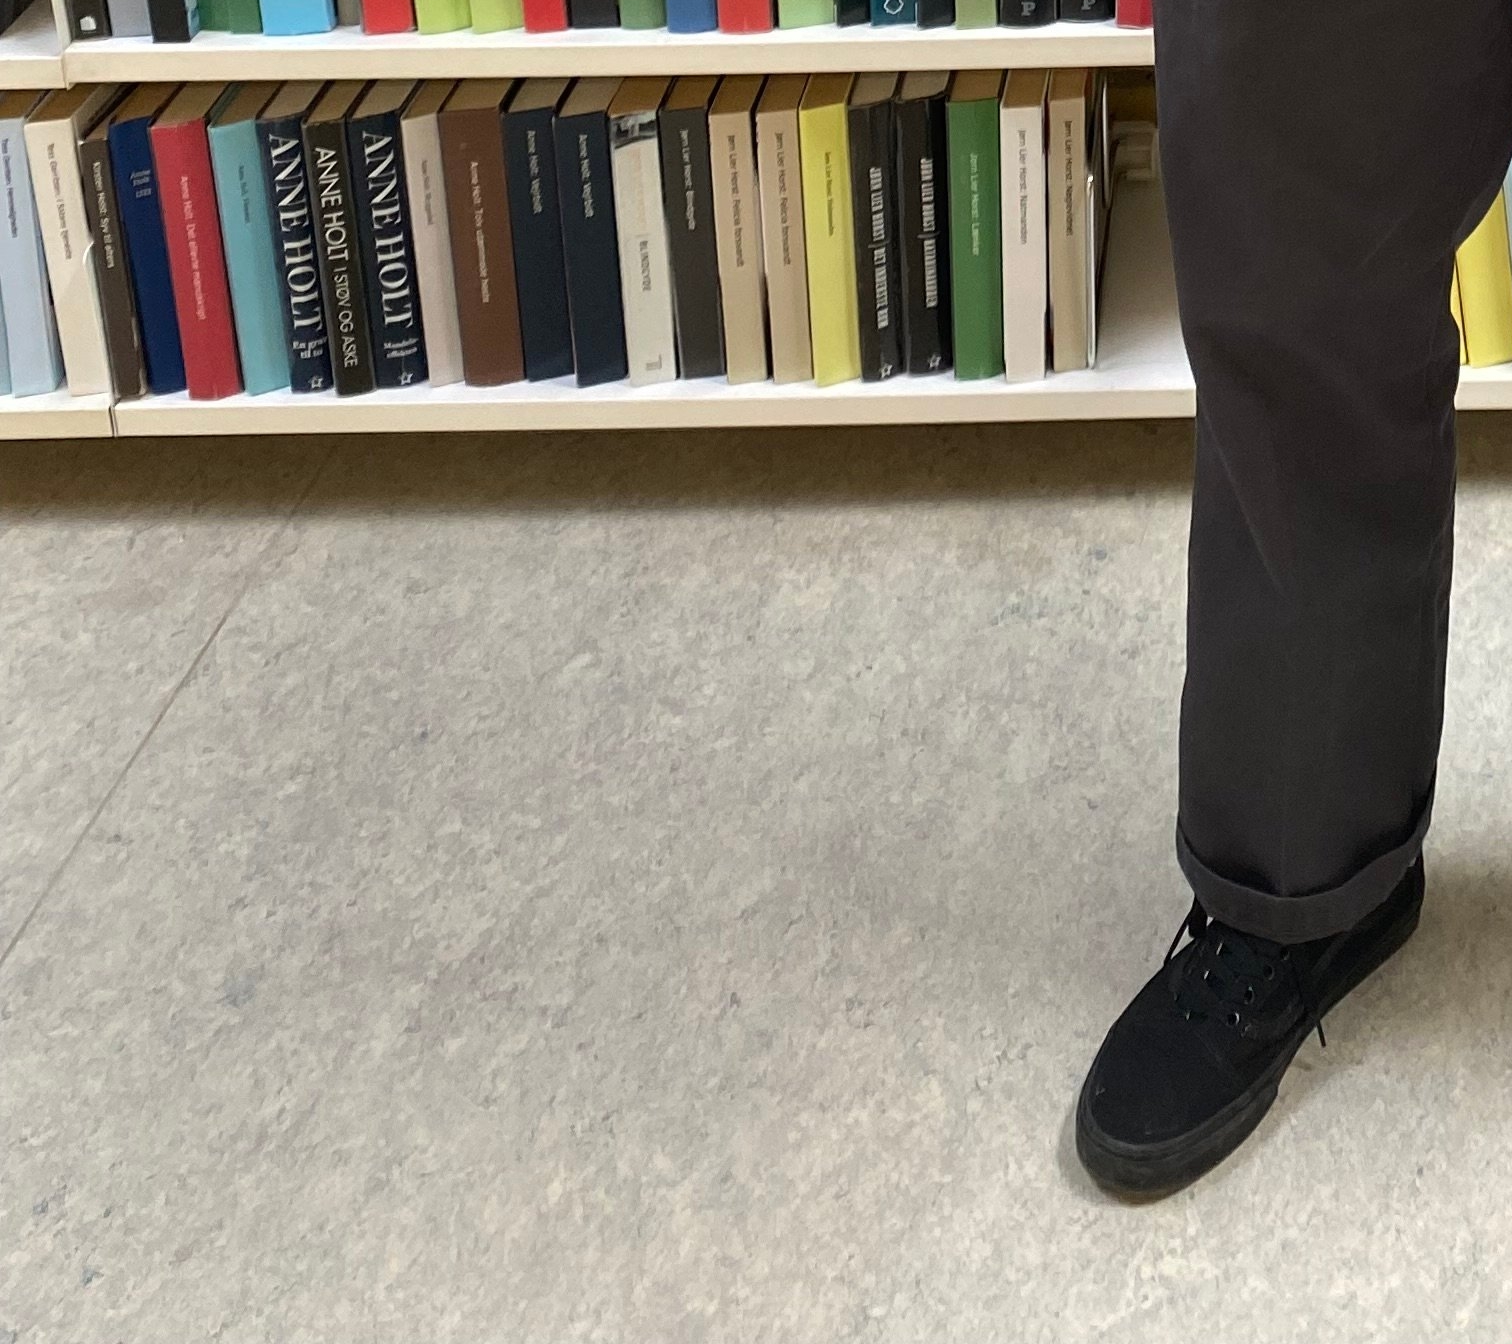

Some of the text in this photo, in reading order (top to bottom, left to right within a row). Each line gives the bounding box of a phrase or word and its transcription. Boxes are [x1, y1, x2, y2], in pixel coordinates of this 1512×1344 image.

[269, 134, 308, 232] ANNE
[314, 147, 341, 206] ANNE
[322, 211, 348, 261] HOLT
[284, 235, 322, 332] HOLT
[333, 275, 351, 307] STØV
[340, 312, 354, 332] OG
[342, 336, 358, 367] ASKE
